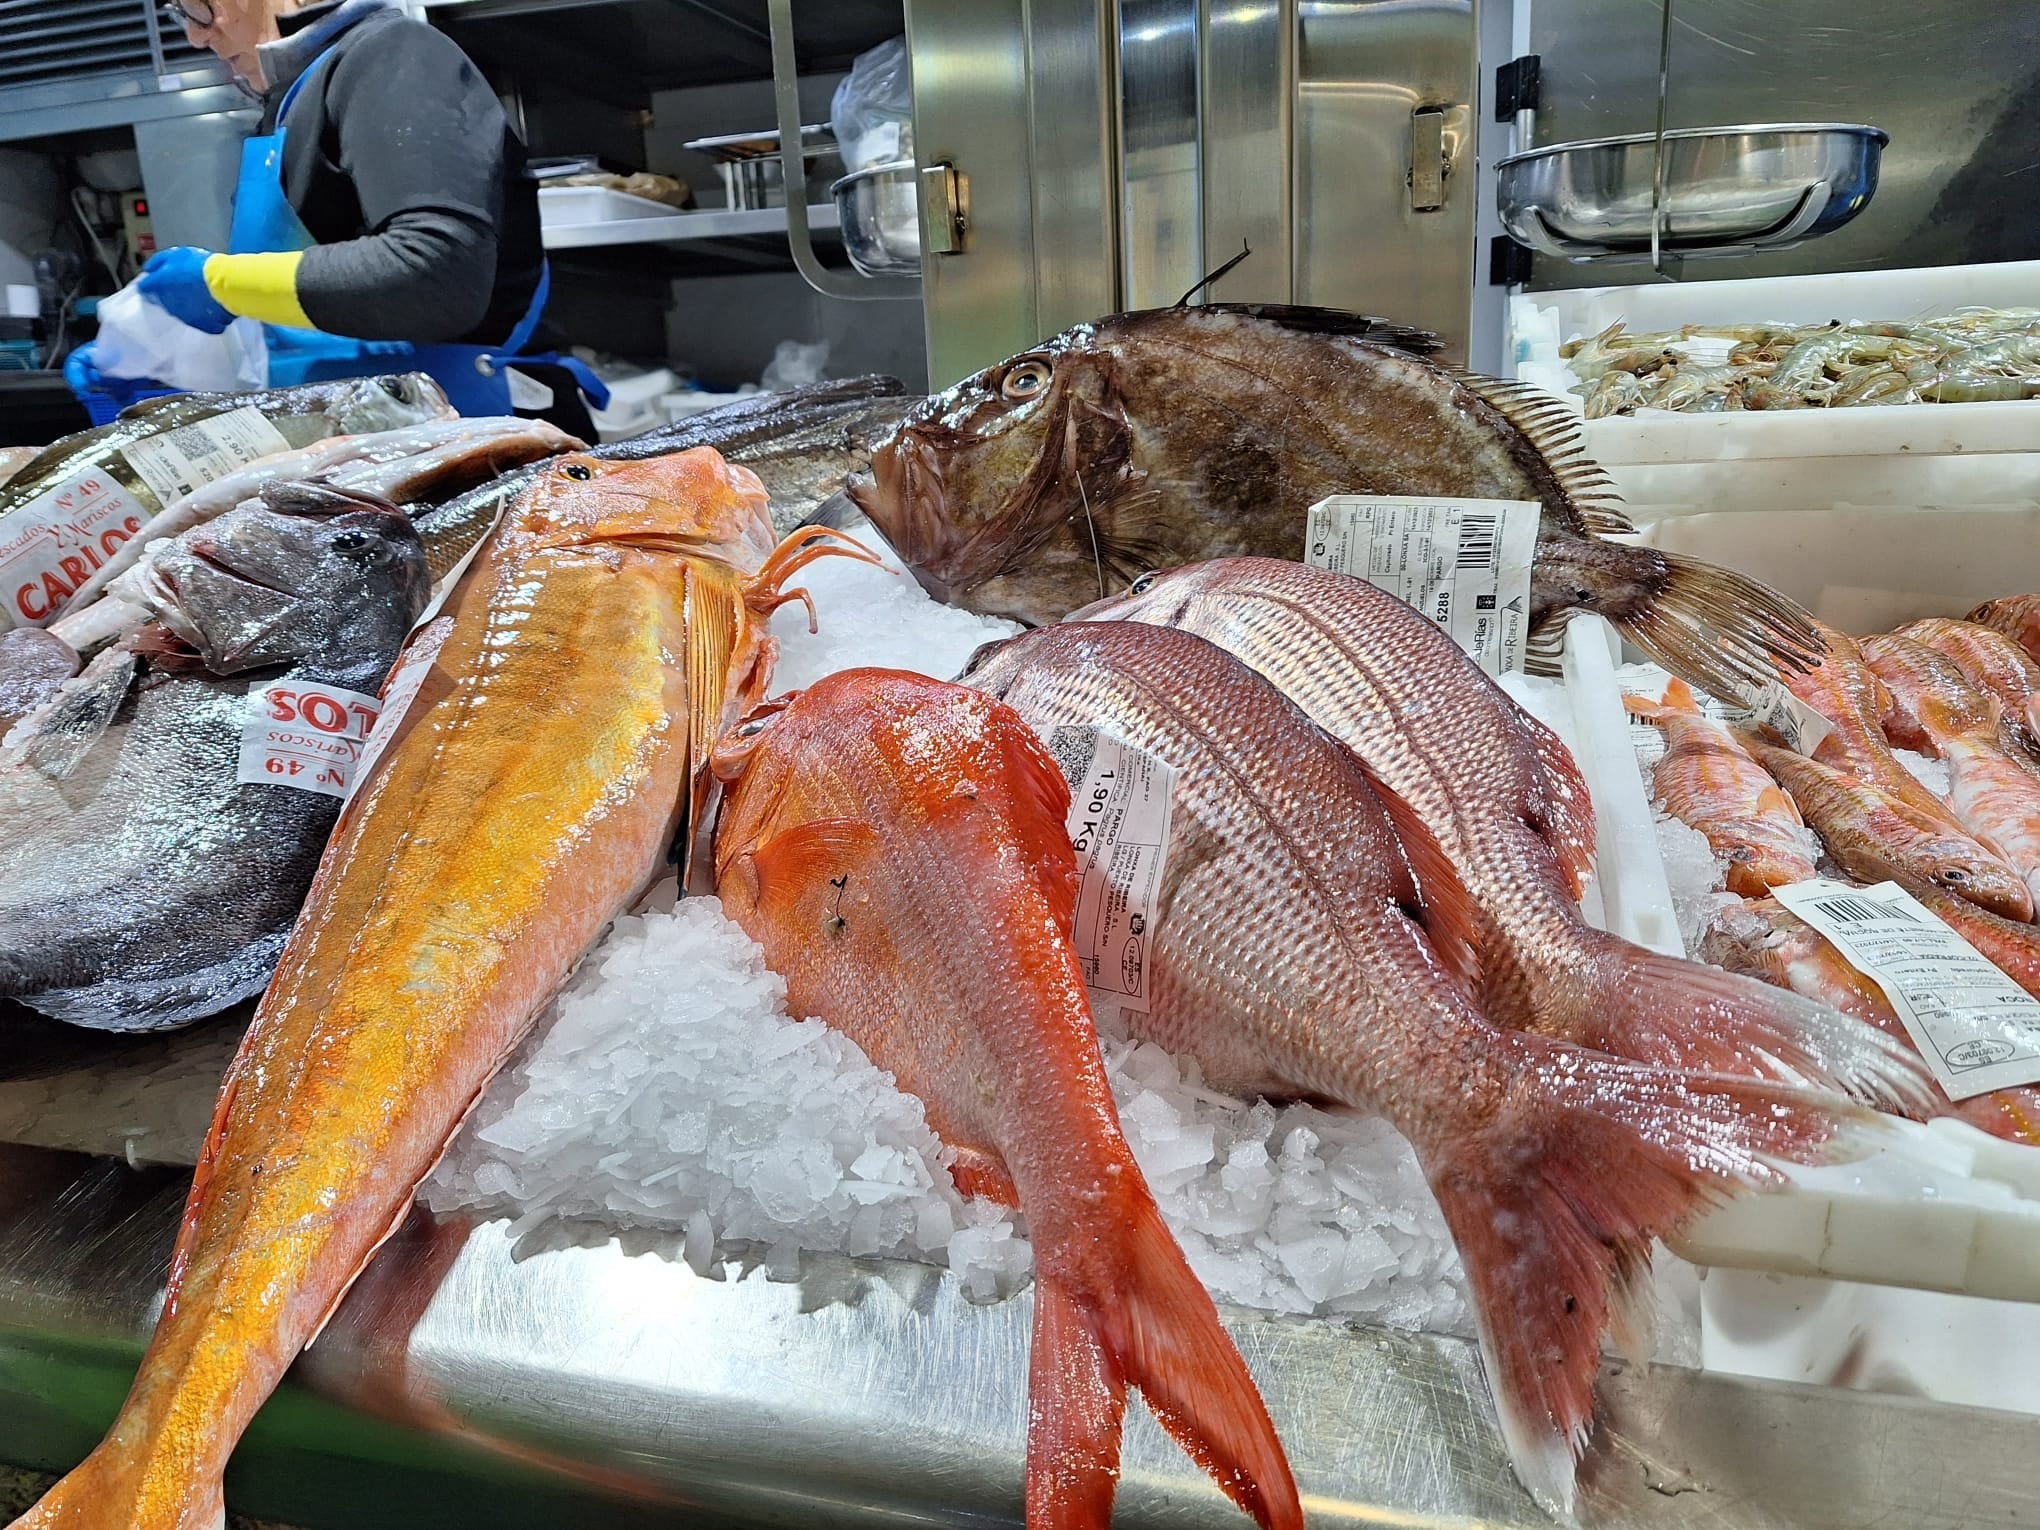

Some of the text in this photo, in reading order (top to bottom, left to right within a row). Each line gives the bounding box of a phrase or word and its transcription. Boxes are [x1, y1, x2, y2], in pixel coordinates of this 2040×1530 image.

[79, 479, 101, 497] 49
[1437, 592, 1449, 622] 5288
[1505, 612, 1518, 647] RIBEIRA
[265, 757, 345, 788] Nº 49
[1073, 769, 1115, 852] 1,90 Kg
[1099, 807, 1114, 838] Pagrus
[1107, 808, 1123, 845] PARGO
[1090, 839, 1103, 869] pagrus
[1110, 845, 1122, 872] RIBEIRA
[1124, 846, 1135, 869] LONXA
[1111, 860, 1125, 889] PUERTO
[1121, 847, 1142, 913] LONXA DE RIBEIRA
[1115, 882, 1125, 911] RIBEIRA
[1104, 891, 1115, 933] PESQUERO
